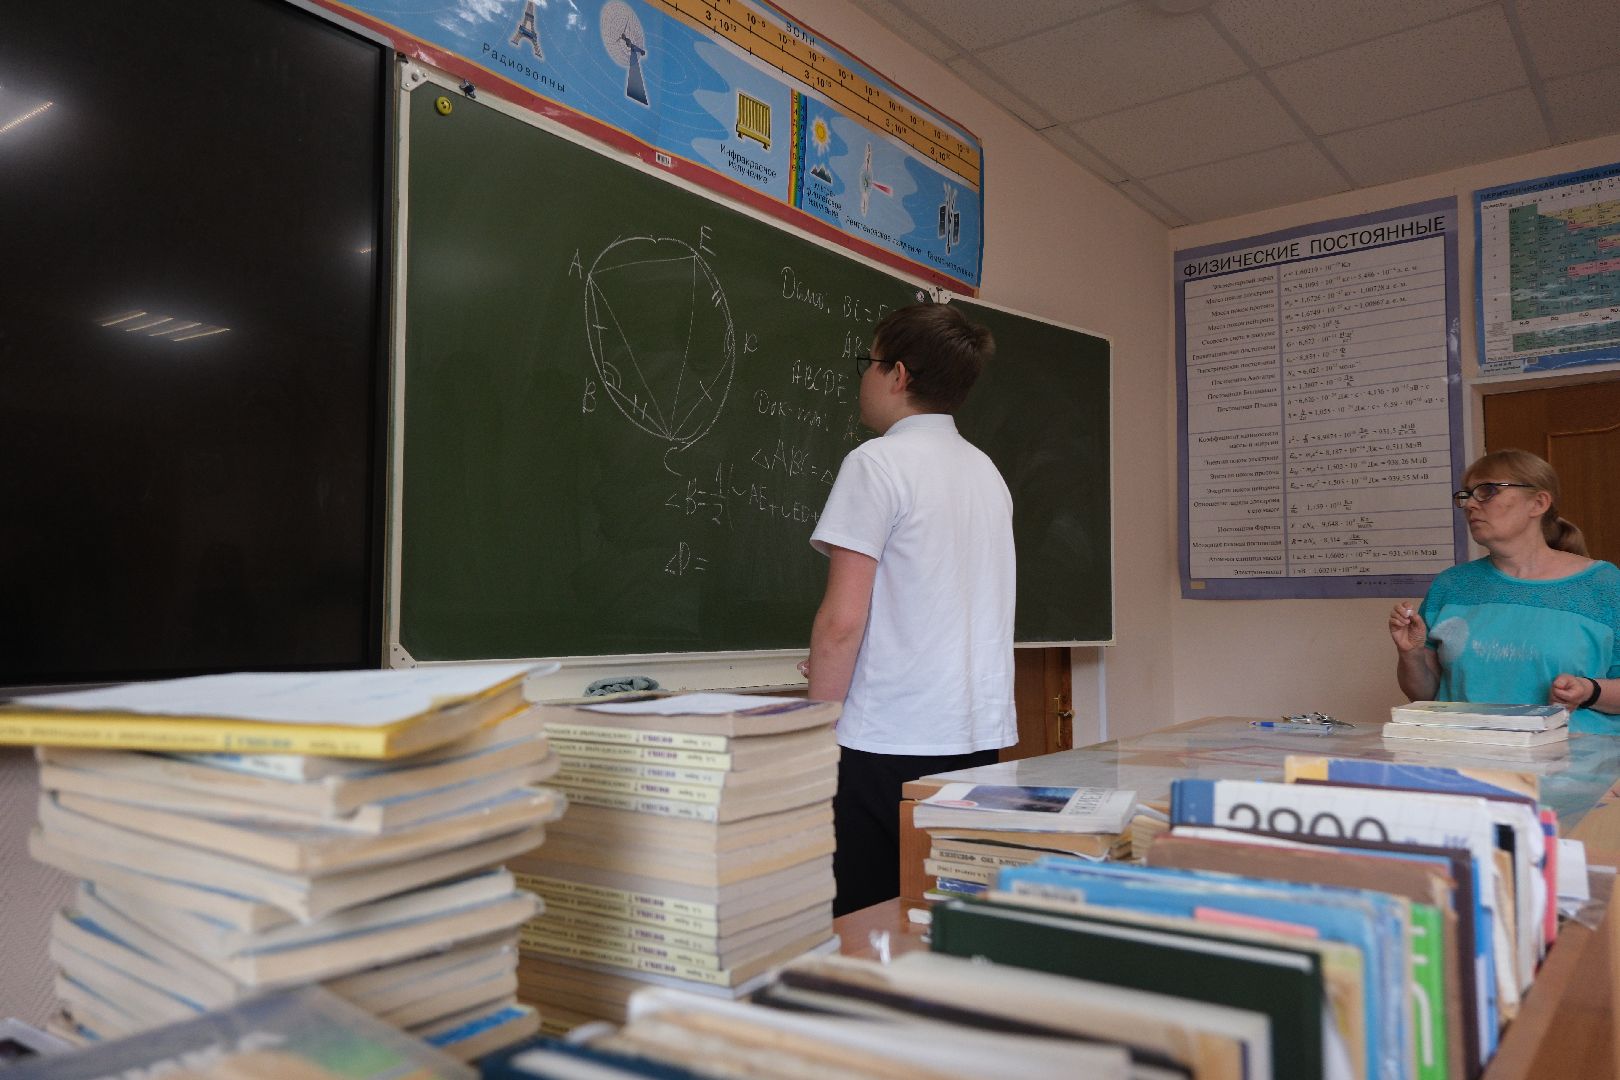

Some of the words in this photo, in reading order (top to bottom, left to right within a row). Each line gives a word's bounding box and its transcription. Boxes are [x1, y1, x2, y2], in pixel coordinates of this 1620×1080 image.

[482, 42, 565, 93] Радиоволны
[720, 143, 777, 178] Инфракрасное
[1184, 242, 1299, 277] ФИЗИЧЕСКИЕ
[1310, 216, 1446, 254] ПОСТОЯННЫЕ
